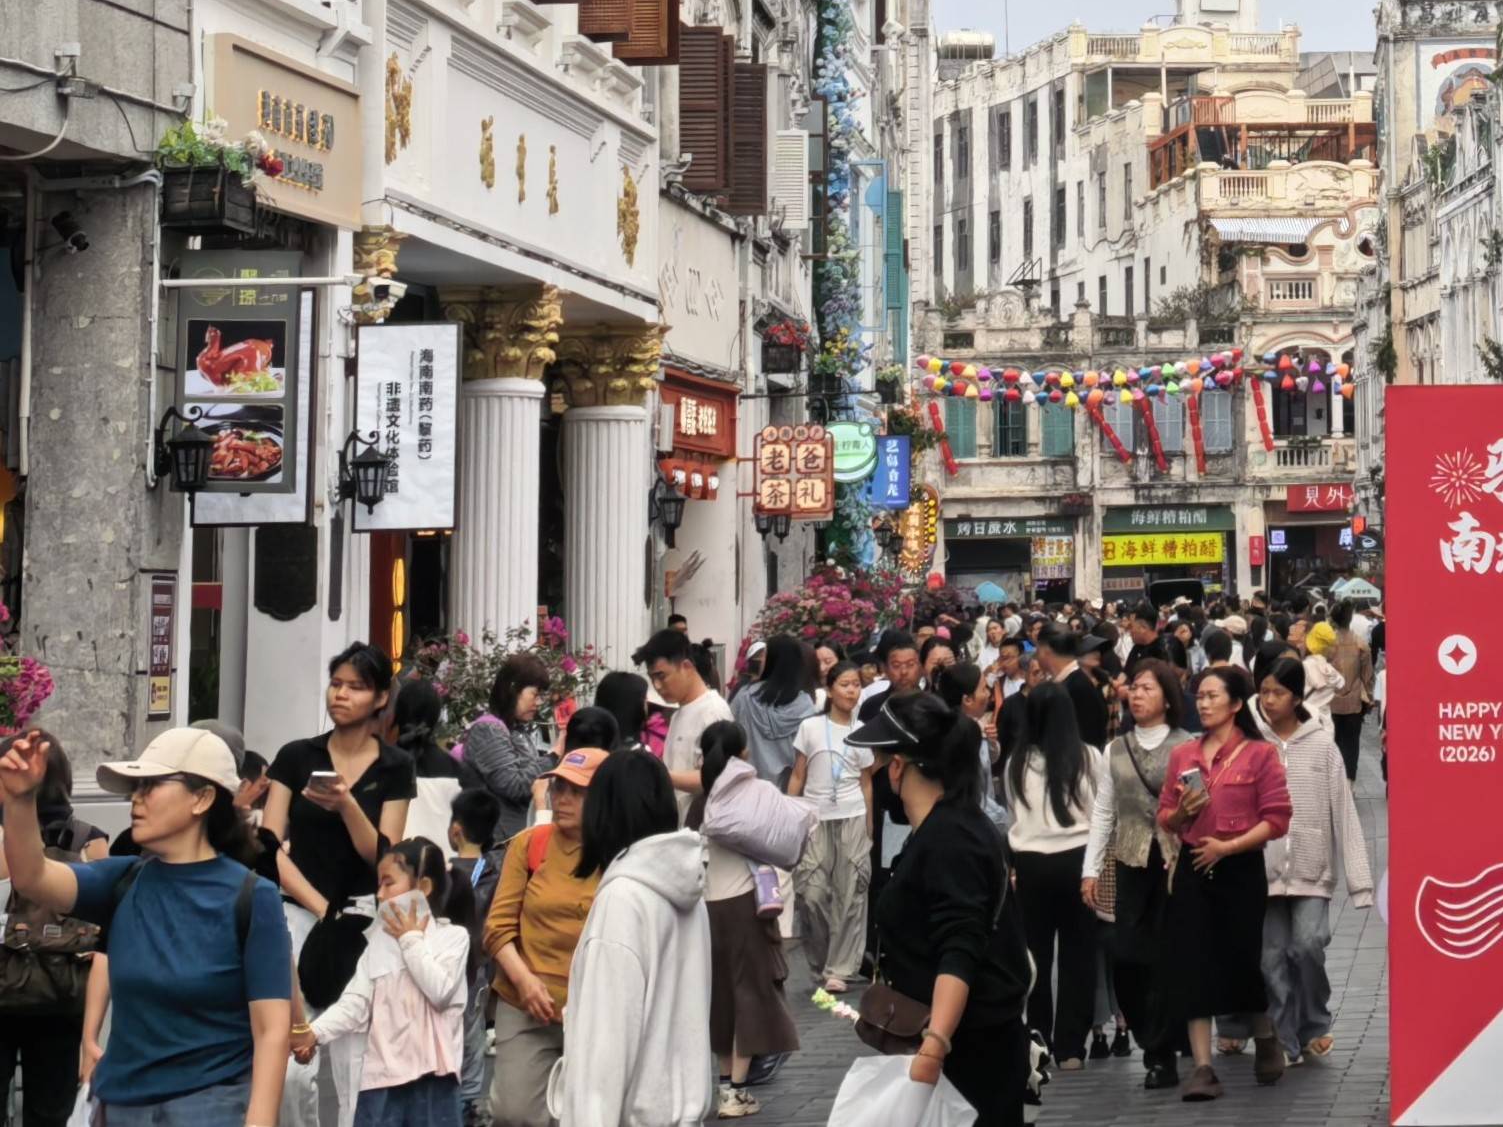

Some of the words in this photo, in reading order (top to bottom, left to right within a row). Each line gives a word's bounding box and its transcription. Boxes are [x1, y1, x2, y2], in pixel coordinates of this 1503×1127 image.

[765, 445, 824, 471] 老爸
[765, 481, 823, 506] 茶礼
[1131, 509, 1207, 525] 海鲜糟粕醋
[957, 520, 1017, 536] 烤甘蔗水
[1439, 702, 1502, 718] HAPPY
[1439, 724, 1483, 740] NEW
[1440, 746, 1496, 762] (2026)
